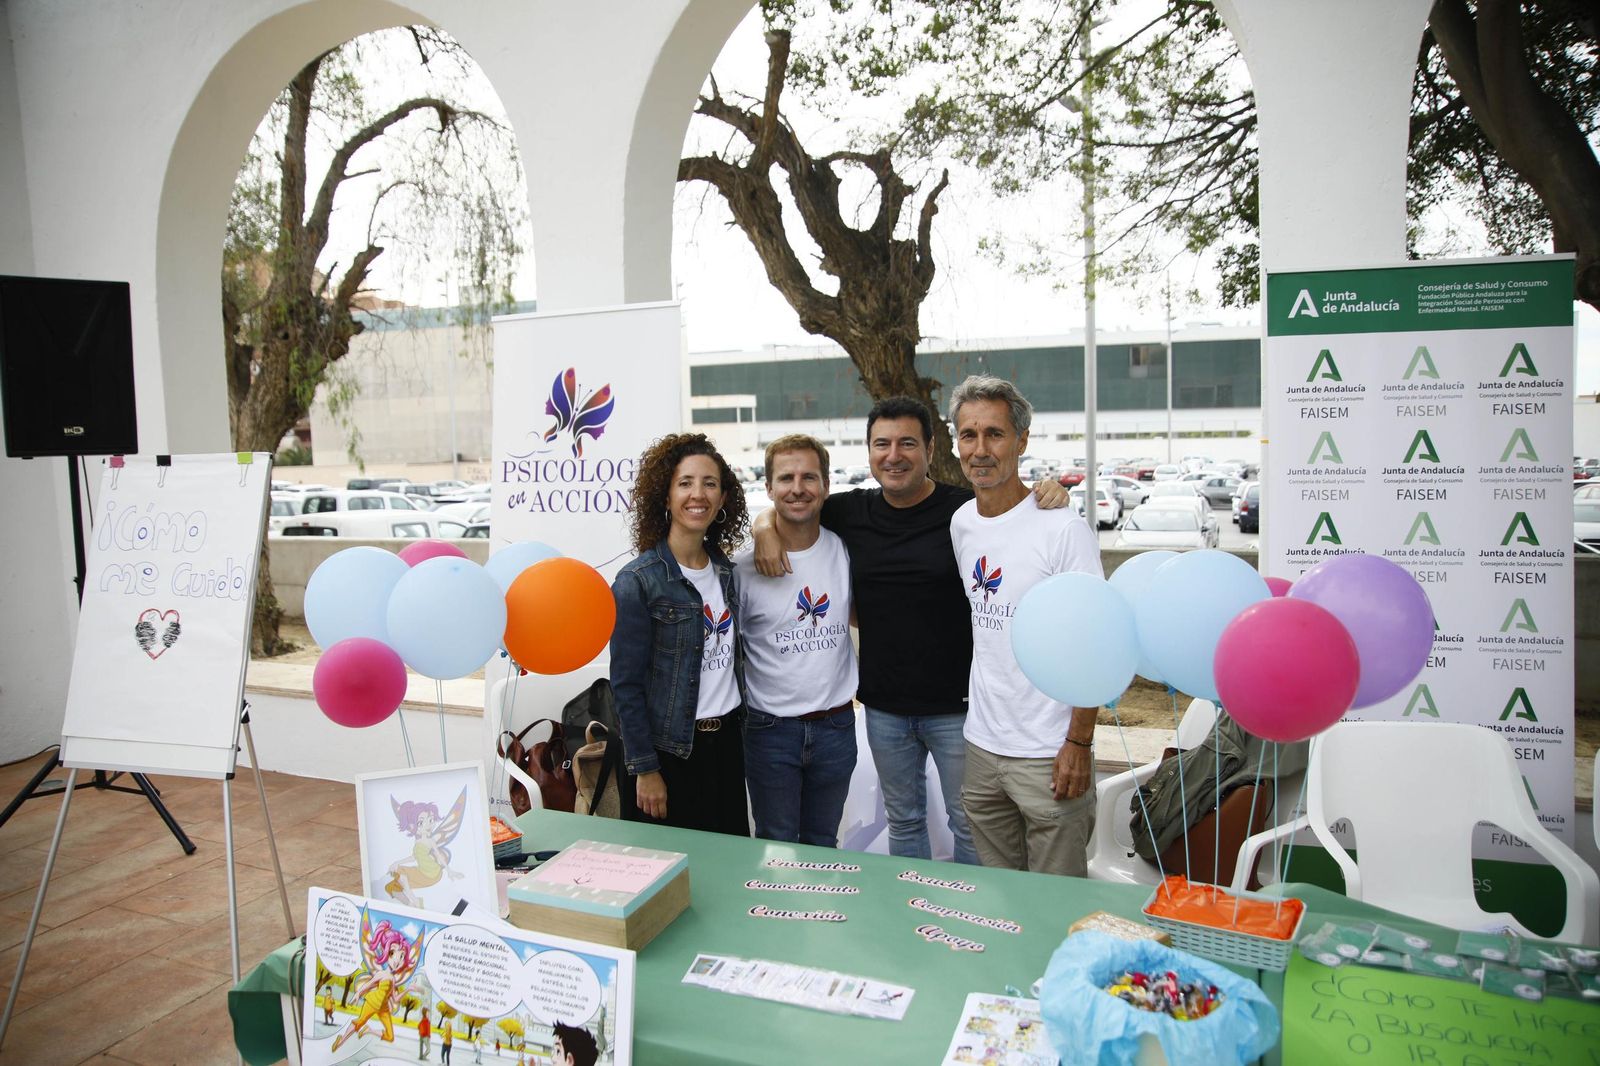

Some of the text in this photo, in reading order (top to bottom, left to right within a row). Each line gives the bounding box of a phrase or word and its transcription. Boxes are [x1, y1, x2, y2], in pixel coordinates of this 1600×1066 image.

[1418, 282, 1460, 292] Consejería
[1463, 282, 1472, 290] de
[1476, 281, 1498, 290] Salud
[1508, 280, 1548, 288] Consumo
[1322, 290, 1357, 301] Junta
[1322, 300, 1400, 313] de Andalucía
[1324, 384, 1366, 392] Andalucía
[1420, 382, 1464, 390] Andalucía
[1518, 379, 1564, 388] Andalucía
[1301, 407, 1348, 418] FAISEM
[1396, 405, 1446, 416] FAISEM
[1493, 403, 1546, 415] FAISEM
[1325, 467, 1366, 475] Andalucía
[1421, 466, 1464, 474] Andalucía
[1518, 466, 1564, 474] Andalucía
[508, 482, 633, 514] en ACCIÓN
[1302, 490, 1349, 500] FAISEM
[1397, 489, 1447, 500] FAISEM
[1494, 488, 1546, 500] FAISEM
[1422, 548, 1465, 556] Andalucía
[1519, 550, 1564, 558] Andalucía
[1494, 572, 1546, 584] FAISEM
[776, 620, 846, 642] PSICOLOGÍA
[1434, 634, 1464, 642] dalucía
[1505, 636, 1516, 644] de
[1518, 636, 1564, 645] Andalucía
[1493, 658, 1545, 671] FAISEM
[1518, 726, 1564, 734] Andalucía
[746, 880, 858, 892] Conocimiento
[454, 936, 478, 946] SALUD
[918, 925, 984, 950] Apoyo
[1446, 995, 1498, 1020] TE
[1312, 1002, 1354, 1027] LA
